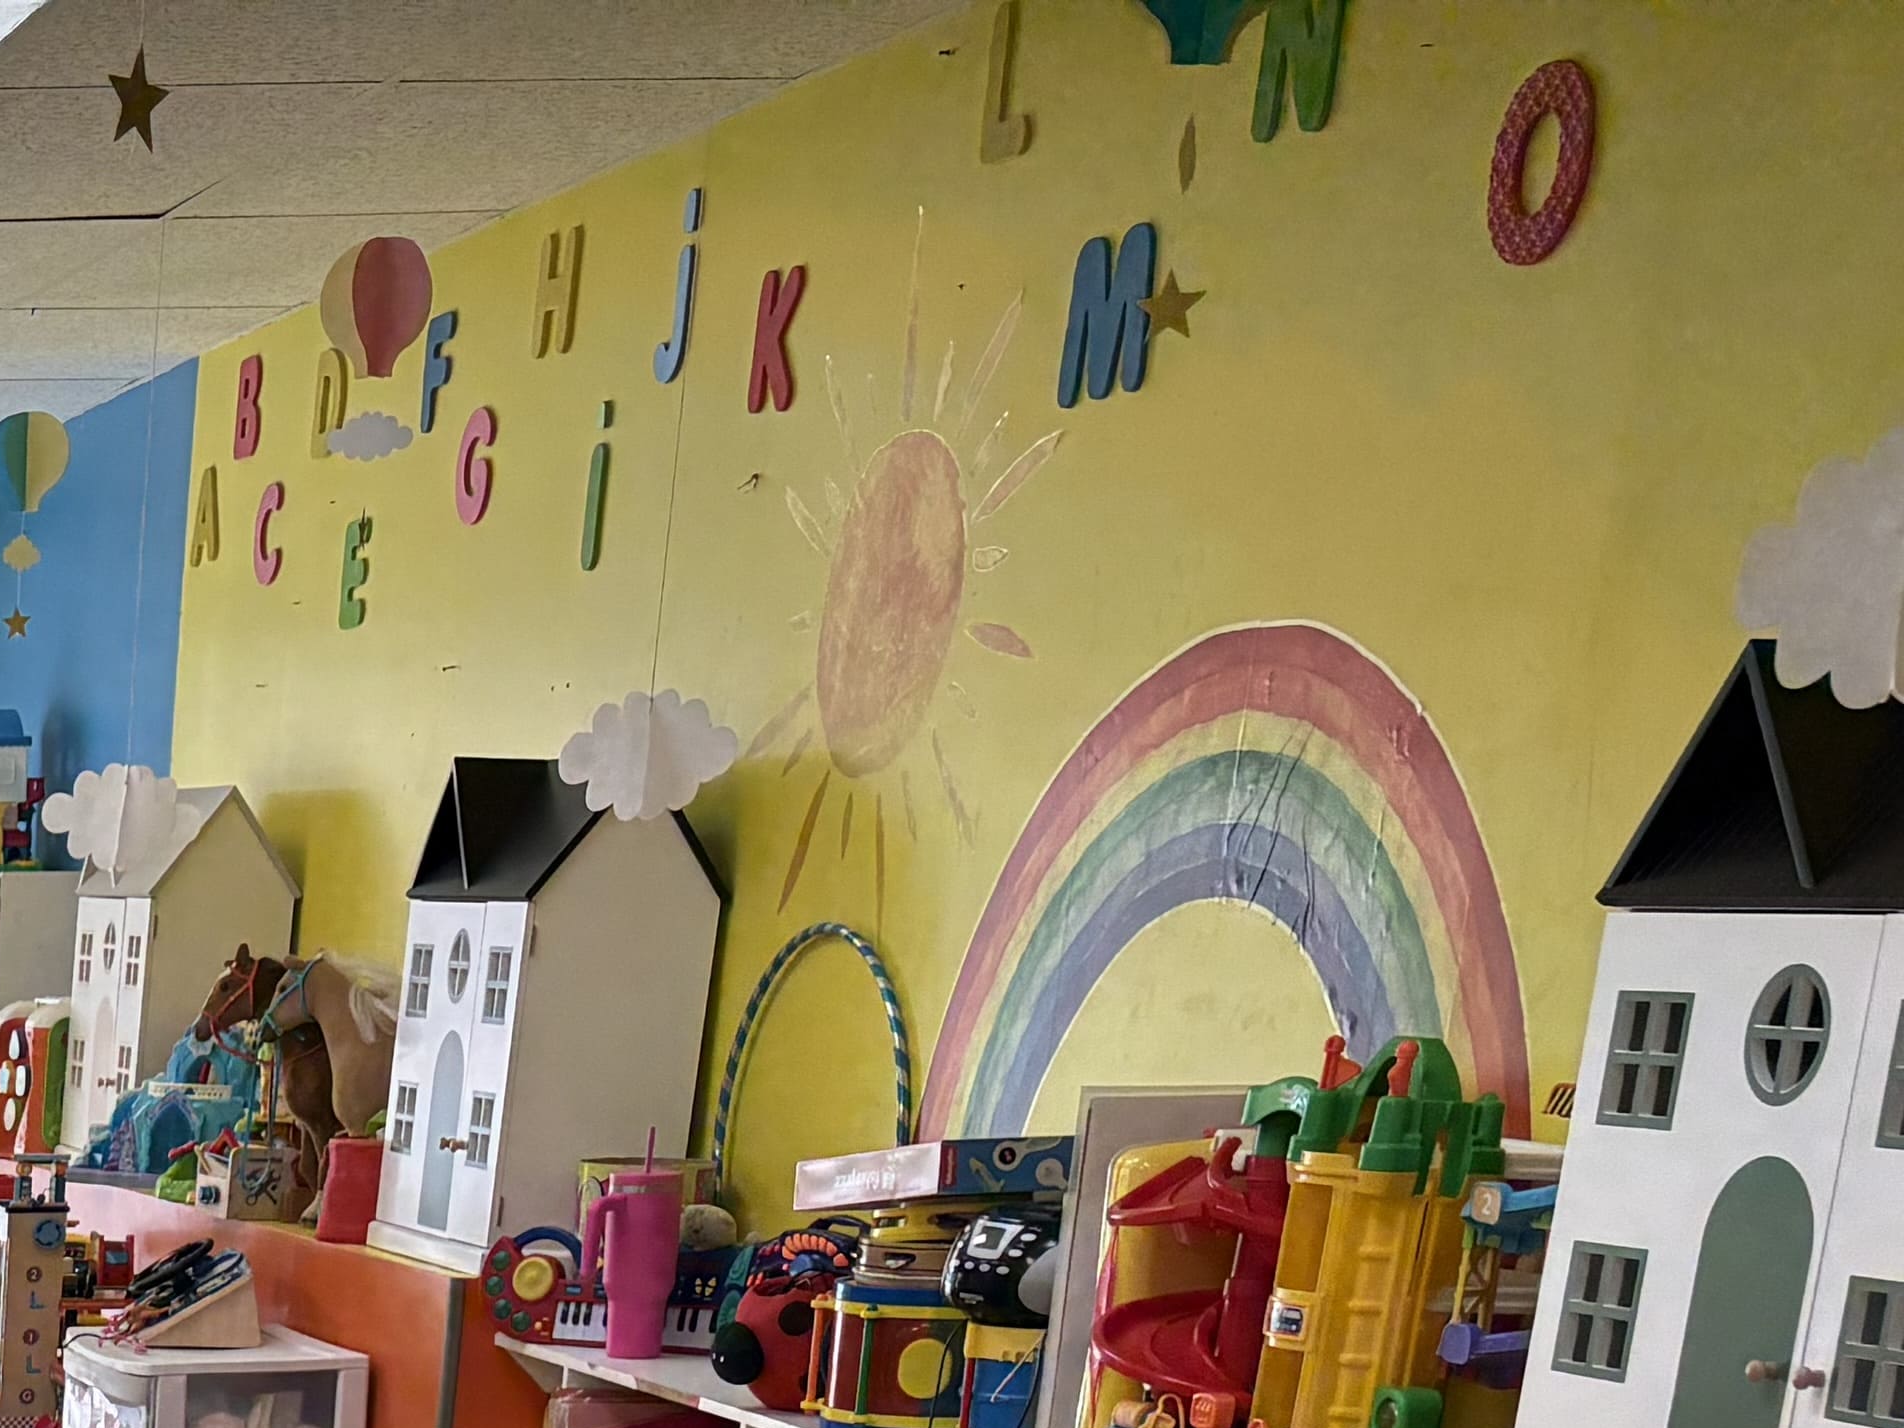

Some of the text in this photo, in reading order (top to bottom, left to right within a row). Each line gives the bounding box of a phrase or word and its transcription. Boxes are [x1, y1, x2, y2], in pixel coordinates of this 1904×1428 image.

[190, 465, 219, 566] A
[254, 482, 283, 585] C
[338, 517, 372, 629] E
[455, 406, 497, 525] G
[747, 265, 806, 413] K
[1058, 222, 1157, 408] M
[1487, 58, 1596, 266] O
[233, 355, 262, 461] B
[420, 311, 458, 433] F
[532, 225, 583, 359] H
[1481, 1193, 1493, 1215] 2
